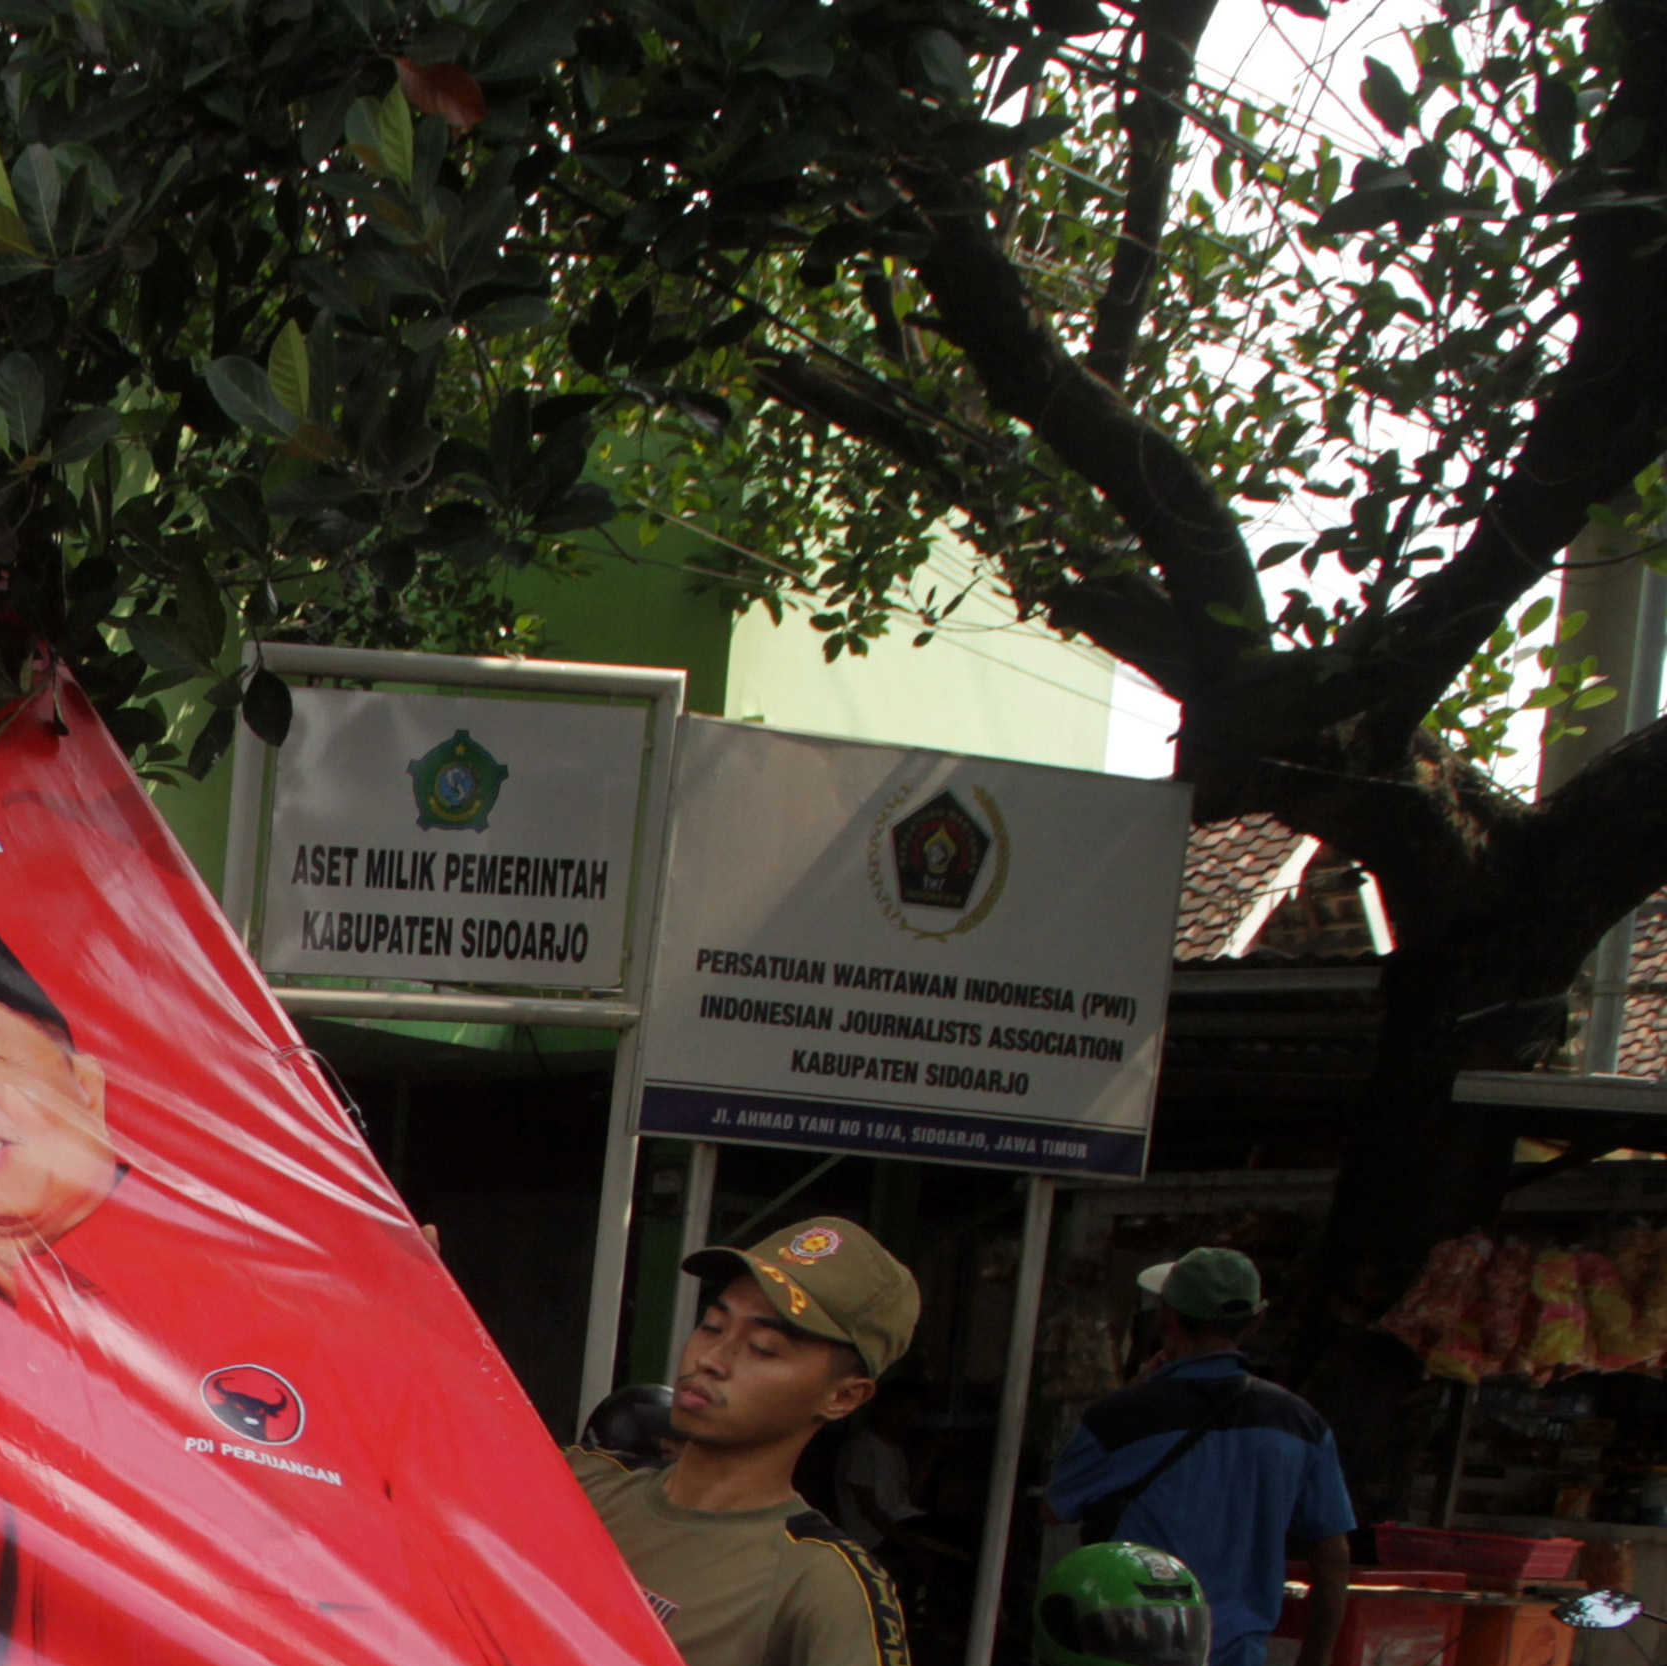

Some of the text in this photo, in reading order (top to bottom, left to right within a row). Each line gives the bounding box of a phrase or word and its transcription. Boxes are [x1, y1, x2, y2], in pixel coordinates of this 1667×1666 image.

[291, 845, 608, 900] ASET MILIK PEMERINTAH
[302, 910, 589, 964] KABUPATEN SIDOARJO
[696, 948, 1137, 1026] PERSATUAN WARTAWAN INDONESIA (PWI)
[700, 995, 1124, 1063] INDONESIAN JOURNALISTS ASSOCIATION
[791, 1049, 1030, 1096] KABUPATEN SIDOARJO
[736, 1110, 794, 1130] AHMAD
[799, 1116, 835, 1135] YANI
[839, 1120, 860, 1136] NO
[911, 1127, 989, 1152] SIDOARJO,
[994, 1135, 1036, 1154] JAWA
[1041, 1140, 1088, 1160] TIMUR
[185, 1437, 342, 1486] PDI PERJUANGAN
